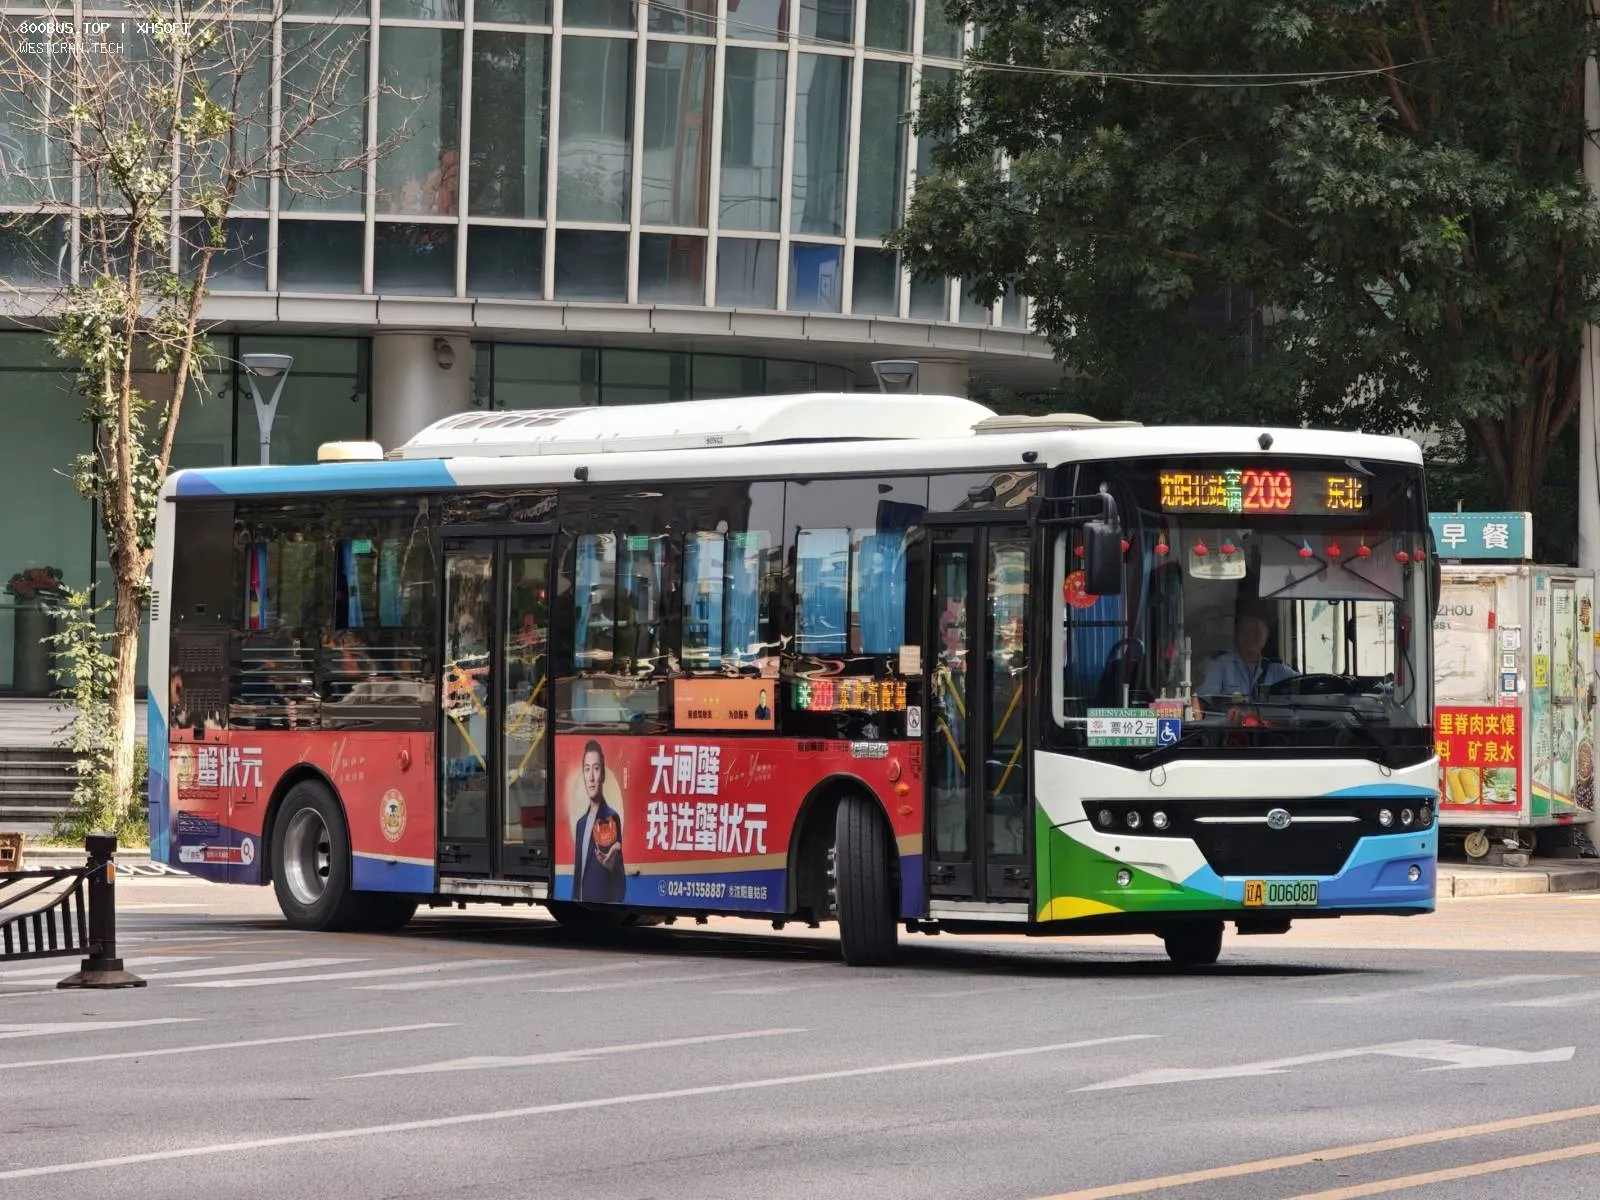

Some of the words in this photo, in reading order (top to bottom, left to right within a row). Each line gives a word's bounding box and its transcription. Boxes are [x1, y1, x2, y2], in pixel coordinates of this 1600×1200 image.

[1243, 471, 1292, 509] 209
[1327, 475, 1363, 509] 东北
[1441, 522, 1509, 549] 早餐
[1090, 709, 1137, 717] SHENYANG
[1439, 714, 1516, 736] 里脊肉夹馍
[1110, 720, 1155, 735] 票价2元
[1468, 741, 1515, 762] 矿泉水
[199, 747, 263, 787] 蟹状元
[650, 744, 721, 795] 大闸蟹
[646, 800, 768, 854] 我选蟹状元
[668, 881, 726, 898] 024-31358887
